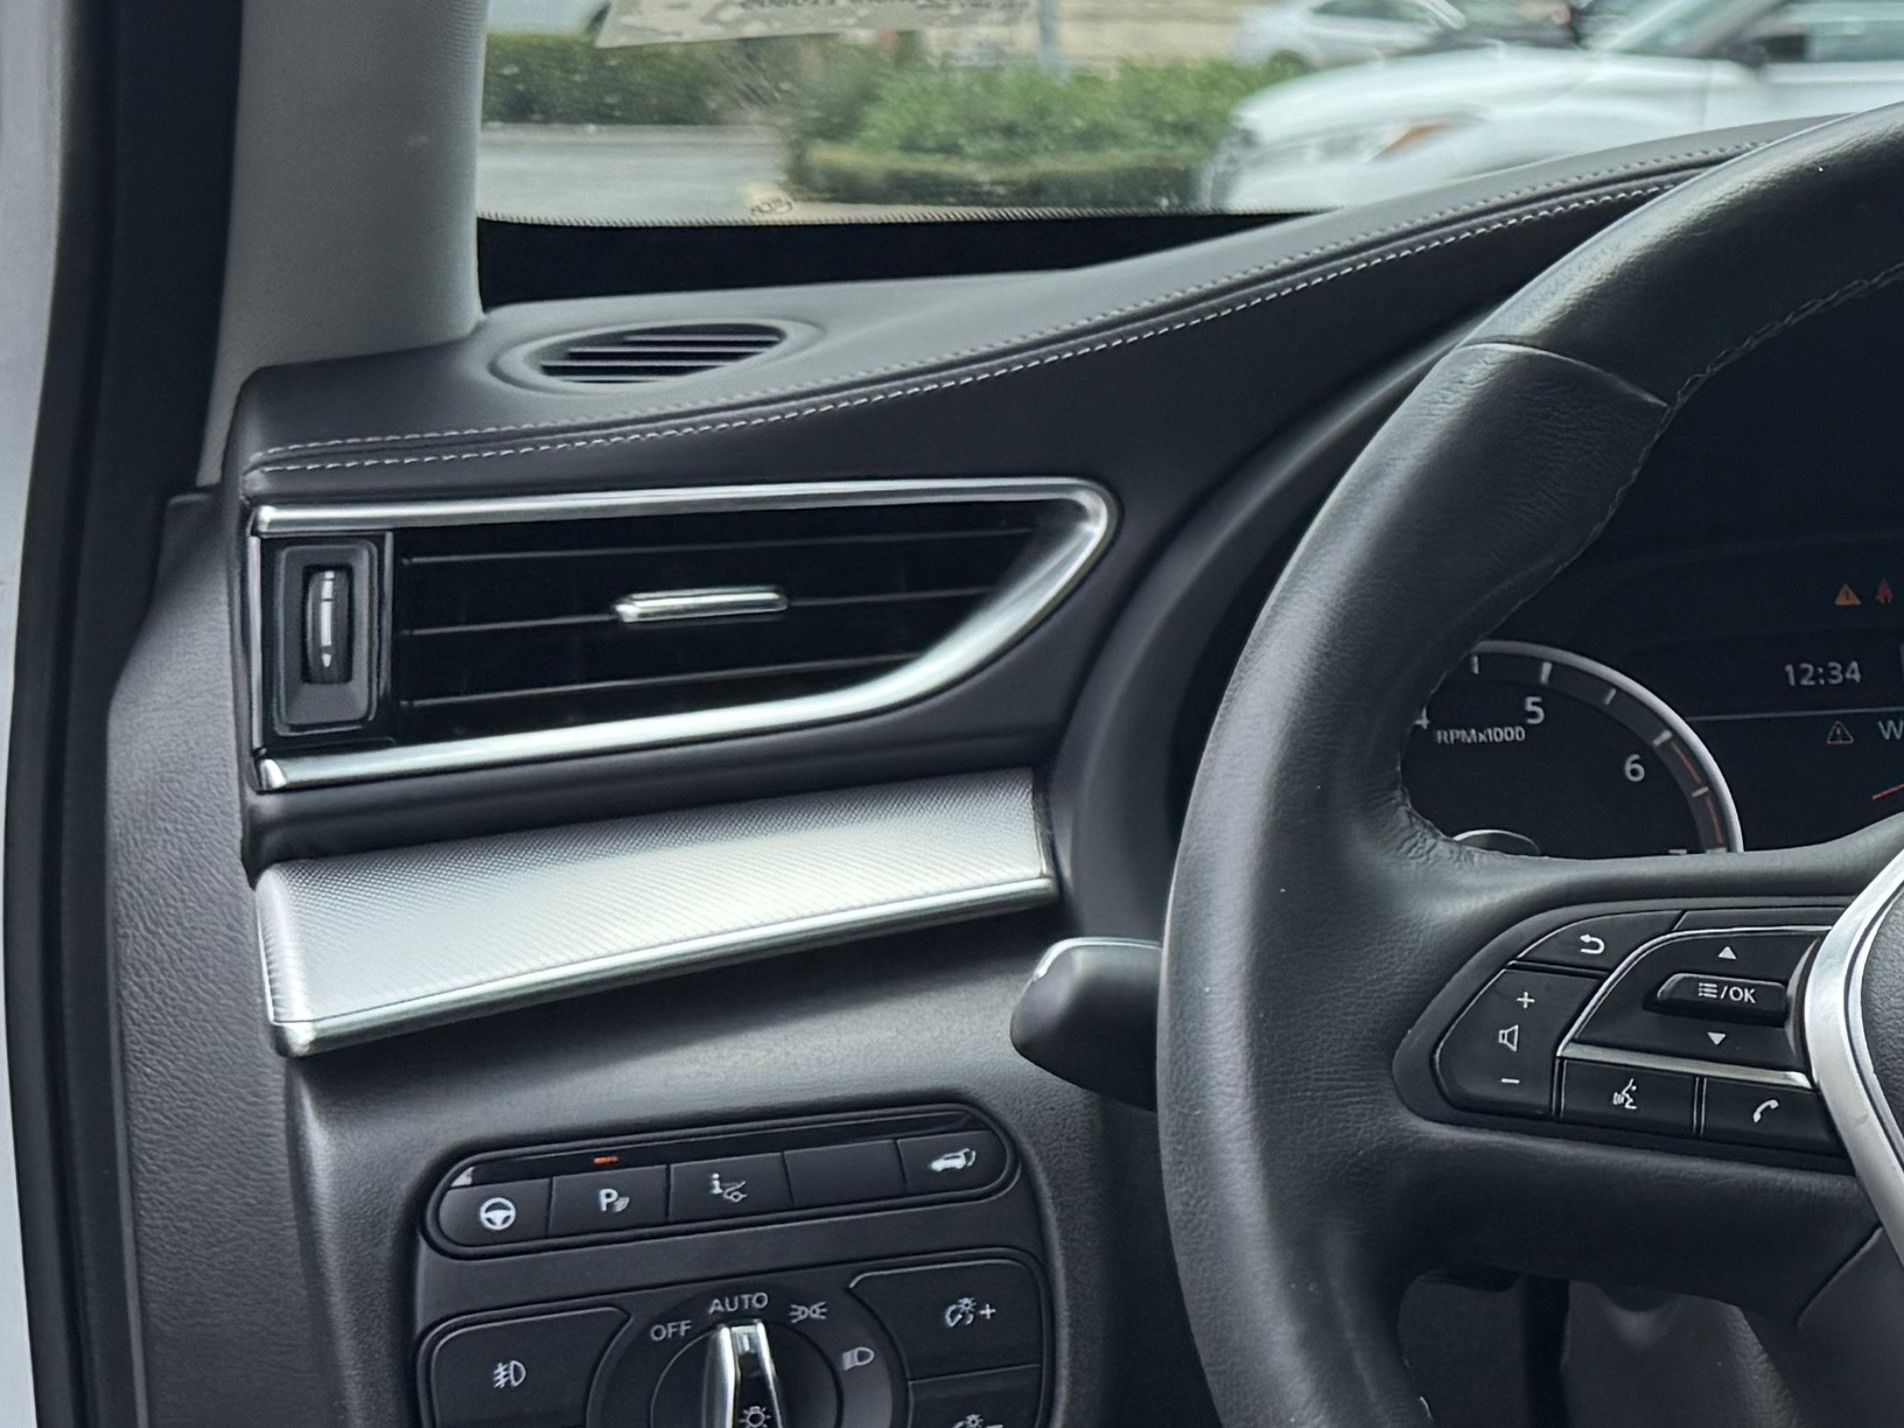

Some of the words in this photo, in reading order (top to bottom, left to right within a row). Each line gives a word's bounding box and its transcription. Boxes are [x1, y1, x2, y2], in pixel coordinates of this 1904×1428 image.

[1785, 660, 1862, 687] 12:34
[1524, 697, 1545, 725] 5
[1624, 755, 1645, 782] 6
[709, 1291, 769, 1315] AUTO
[649, 1320, 692, 1343] OFF
